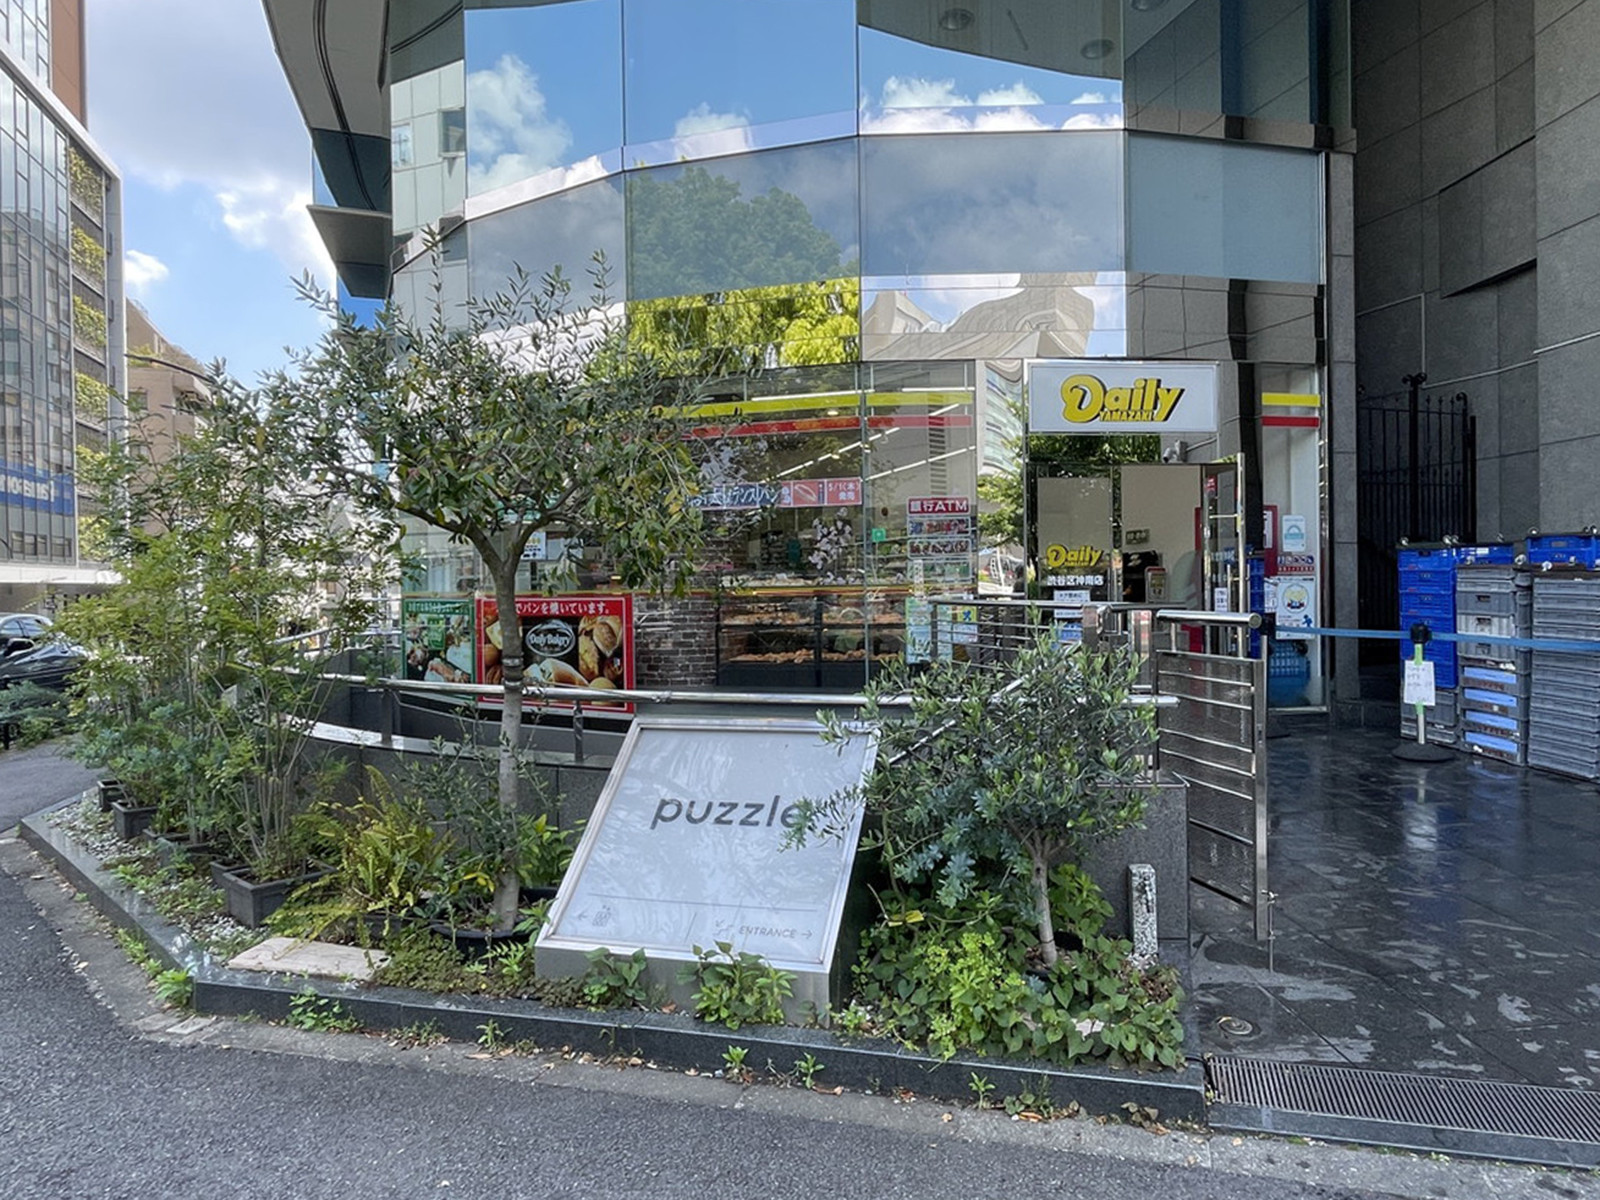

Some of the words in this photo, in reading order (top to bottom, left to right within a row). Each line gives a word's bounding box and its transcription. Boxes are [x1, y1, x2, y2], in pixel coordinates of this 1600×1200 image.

[1061, 374, 1185, 423] Daily
[1100, 411, 1155, 422] YAMAZAKI
[1047, 544, 1103, 568] Daily
[496, 601, 610, 615] でパンを焼いています。
[650, 795, 803, 830] puzzle
[738, 925, 797, 939] ENTRANCE
